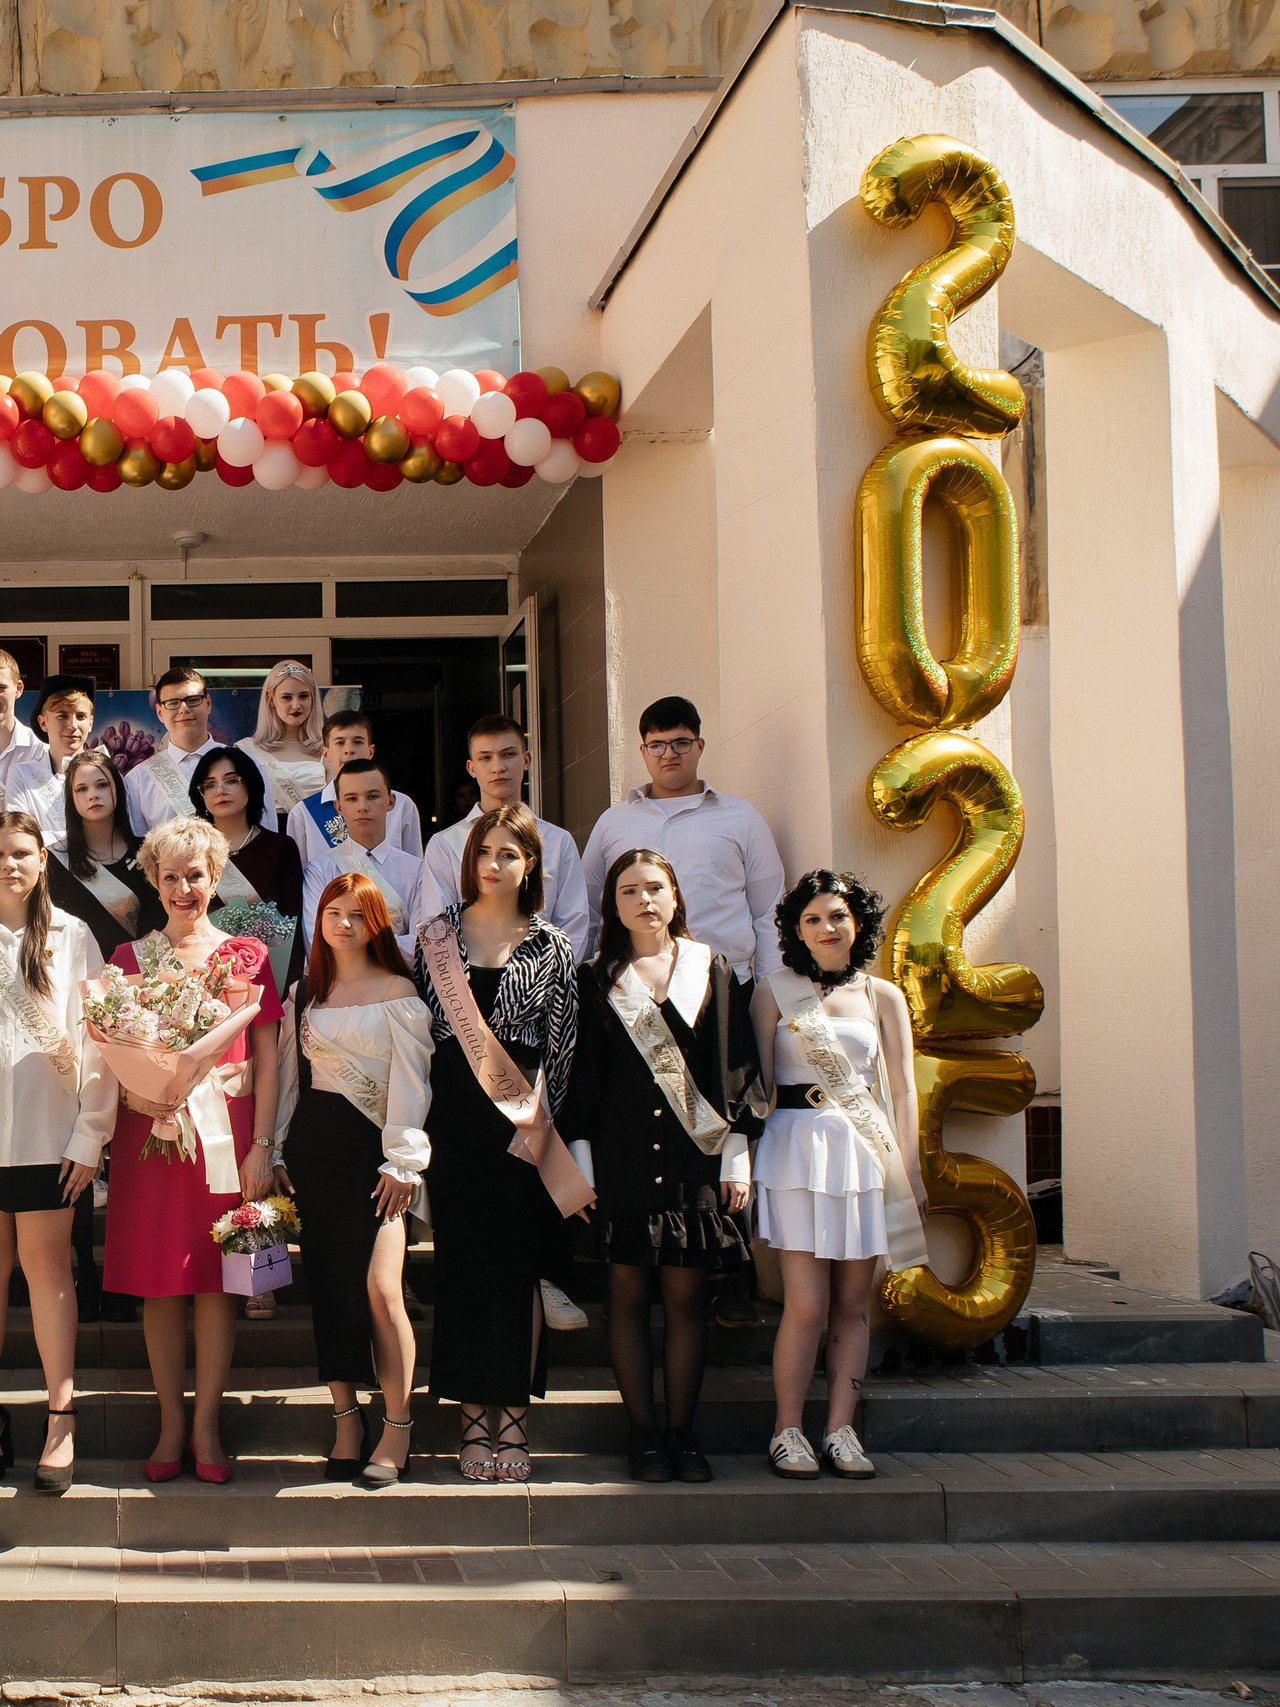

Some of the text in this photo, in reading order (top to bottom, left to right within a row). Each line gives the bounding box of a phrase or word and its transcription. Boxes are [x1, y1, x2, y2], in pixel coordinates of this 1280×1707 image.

[34, 1027, 81, 1076] 2025
[434, 945, 531, 1112] Выпускница 2025
